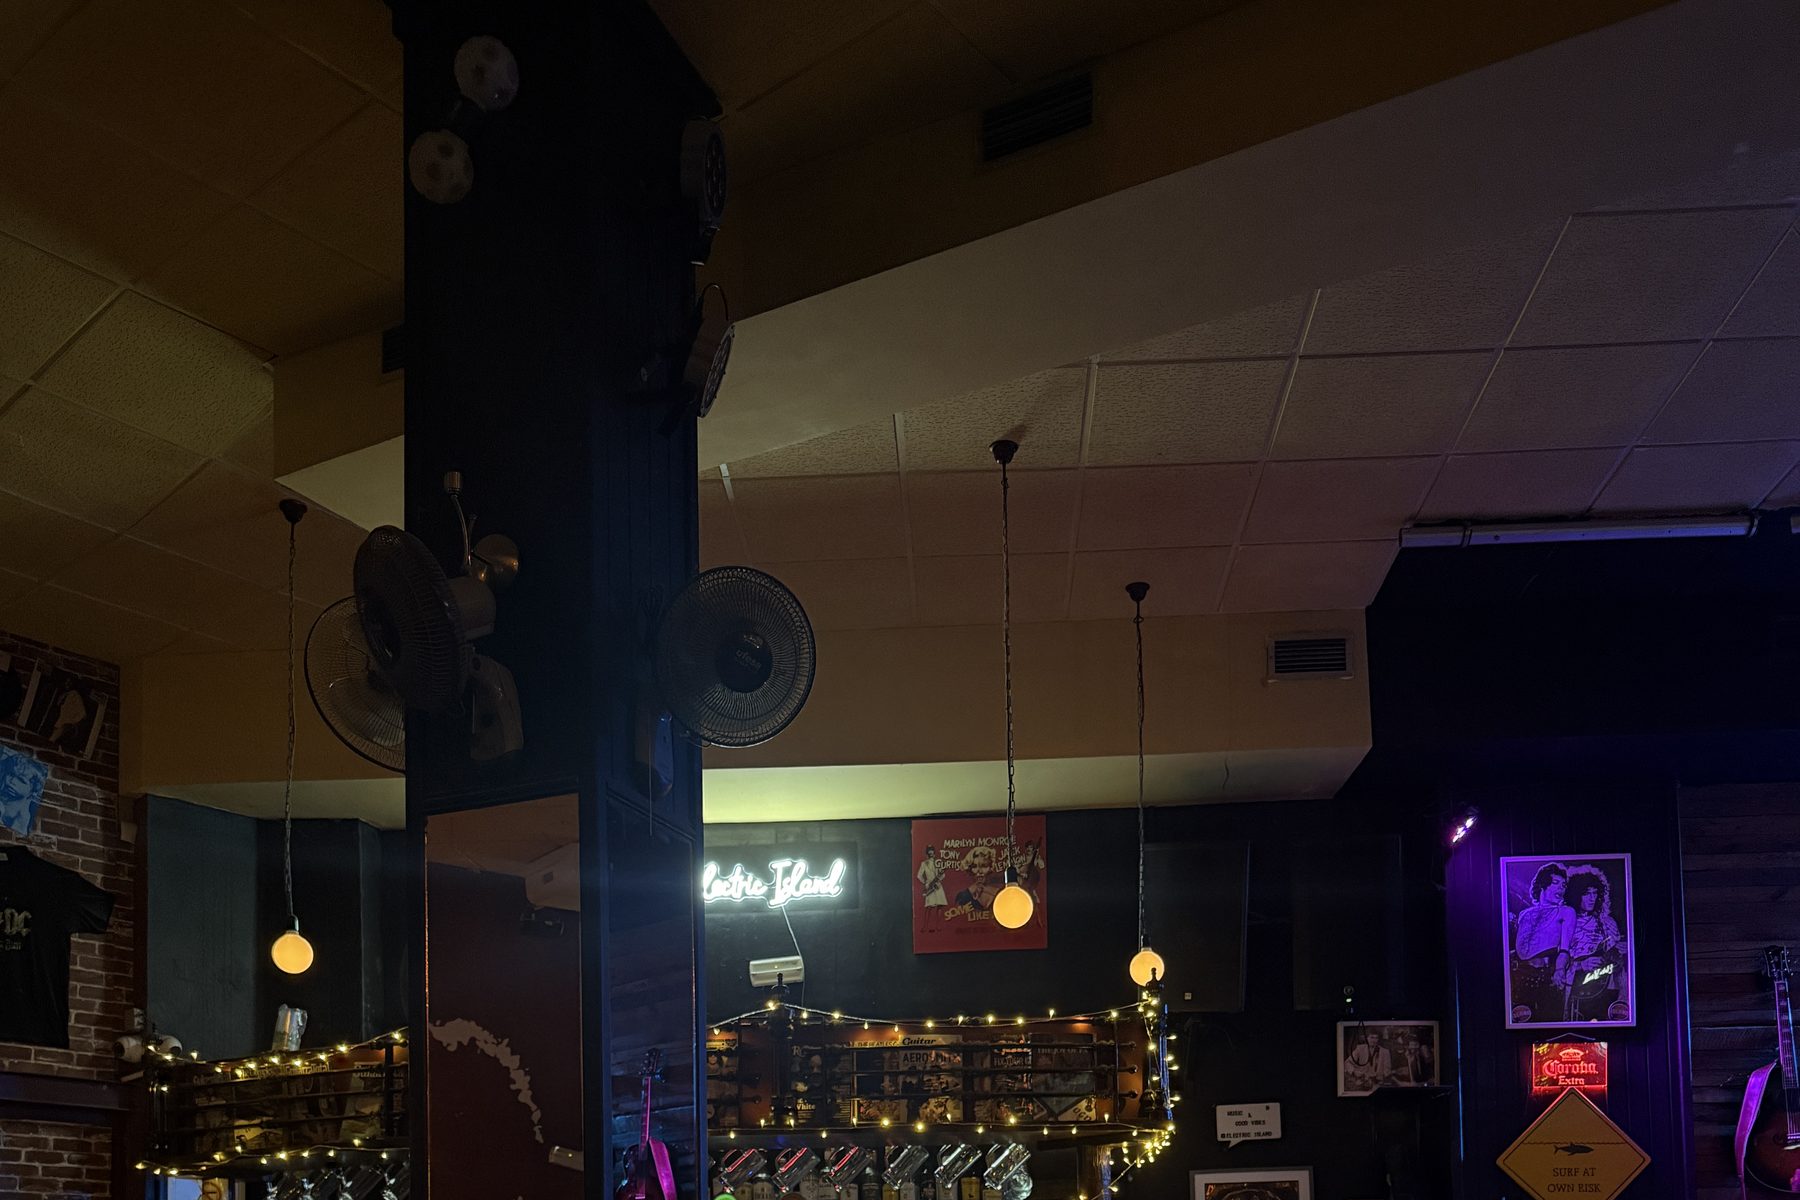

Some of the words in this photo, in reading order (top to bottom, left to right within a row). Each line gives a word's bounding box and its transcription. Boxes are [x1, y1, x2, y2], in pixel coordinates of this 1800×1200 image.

[943, 838, 976, 849] MARILYN
[940, 849, 960, 860] TONY
[935, 859, 961, 872] CURTIS
[703, 861, 769, 902] lectric
[768, 859, 845, 908] Island
[943, 902, 975, 921] SOME
[967, 910, 991, 922] LIKE
[901, 1037, 937, 1046] Guitar
[1542, 1059, 1599, 1079] Corona
[1557, 1075, 1585, 1086] Extra
[1234, 1119, 1249, 1127] GOOD
[1250, 1119, 1266, 1127] VIBES
[1552, 1167, 1580, 1177] SURF
[1582, 1167, 1597, 1177] AT
[1546, 1183, 1575, 1193] OWN
[1578, 1183, 1602, 1193] RISK
